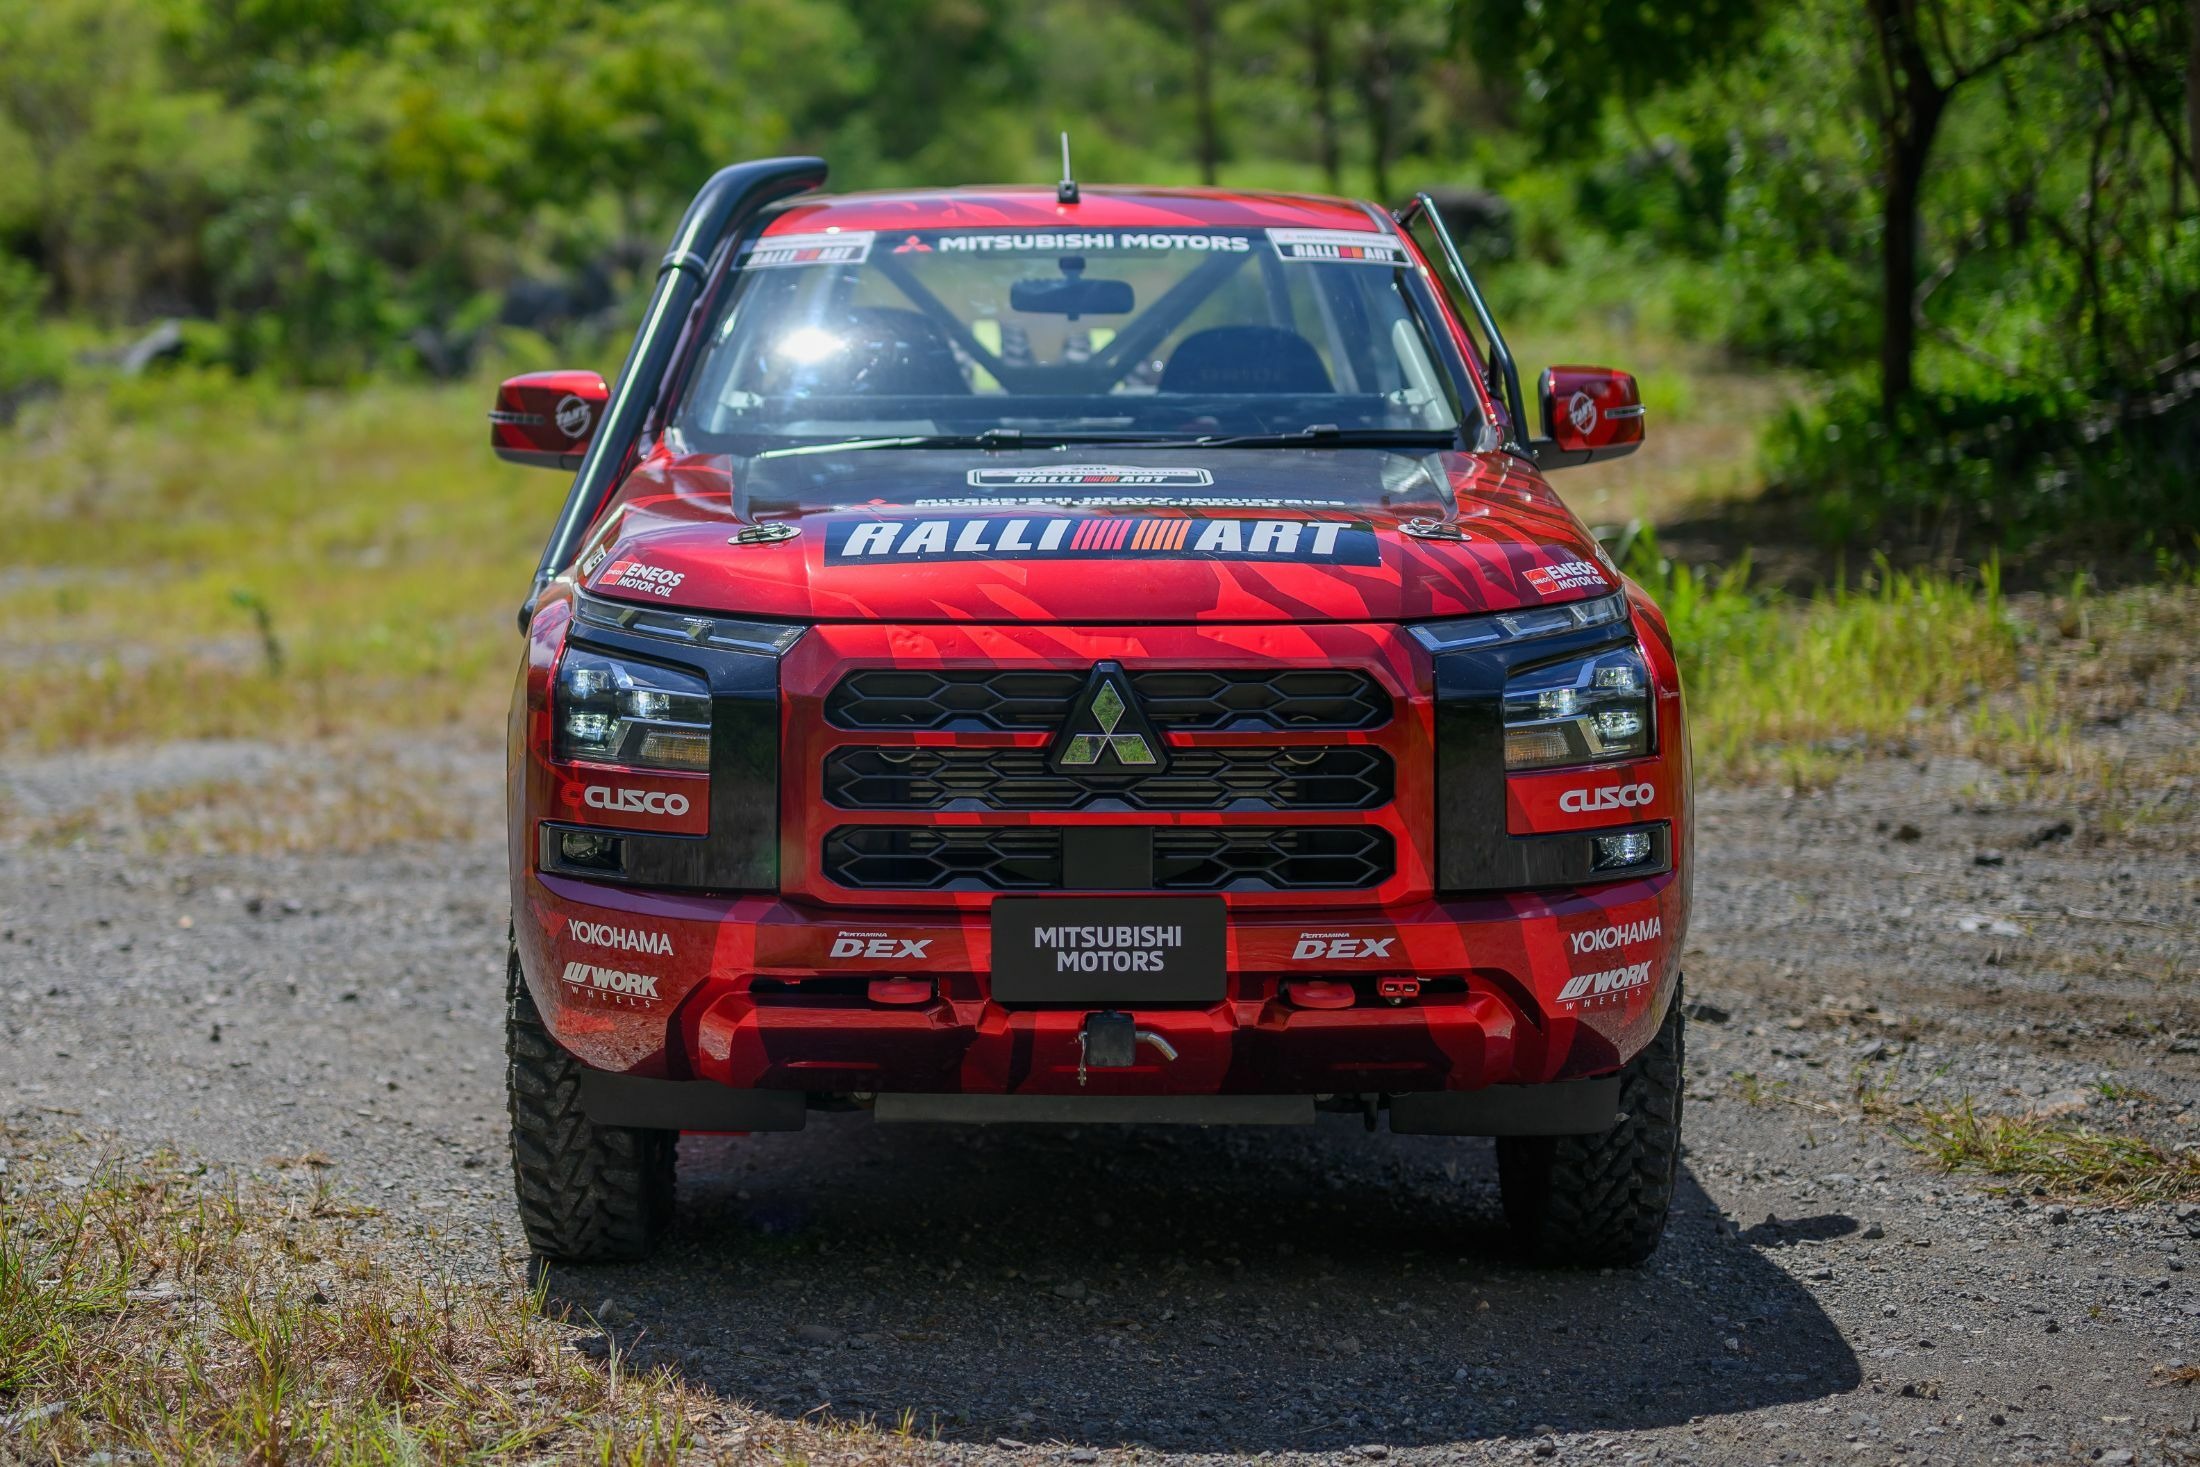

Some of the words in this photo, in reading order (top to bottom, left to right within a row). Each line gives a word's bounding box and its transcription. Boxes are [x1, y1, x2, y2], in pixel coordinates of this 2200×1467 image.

[939, 233, 1114, 251] MITSUBISHI
[1120, 234, 1250, 252] MOTORS
[1293, 243, 1340, 258] RALLI
[1364, 247, 1395, 261] ART
[1014, 475, 1084, 483] RALLI
[1119, 475, 1168, 483] ART
[841, 519, 1072, 556] RALLI
[1193, 519, 1352, 555] ART
[624, 562, 685, 587] ENEOS
[1544, 561, 1599, 580] ENEOS
[617, 576, 656, 593] MOTOR
[655, 585, 673, 597] OIL
[1557, 576, 1594, 590] MOTOR
[584, 785, 690, 816] CUSCO
[1559, 782, 1655, 813] CUSCO
[568, 918, 674, 956] YOKOHAMA
[1034, 926, 1182, 948] MITSUBISHI
[1570, 916, 1662, 955] YOKOHAMA
[829, 938, 934, 958] DEX
[1292, 937, 1396, 959] DEX
[1057, 950, 1165, 972] MOTORS
[591, 966, 659, 998] WORK
[1593, 960, 1653, 994] WORK
[571, 986, 651, 1009] WHEELS
[1565, 987, 1641, 1011] WHEELS
